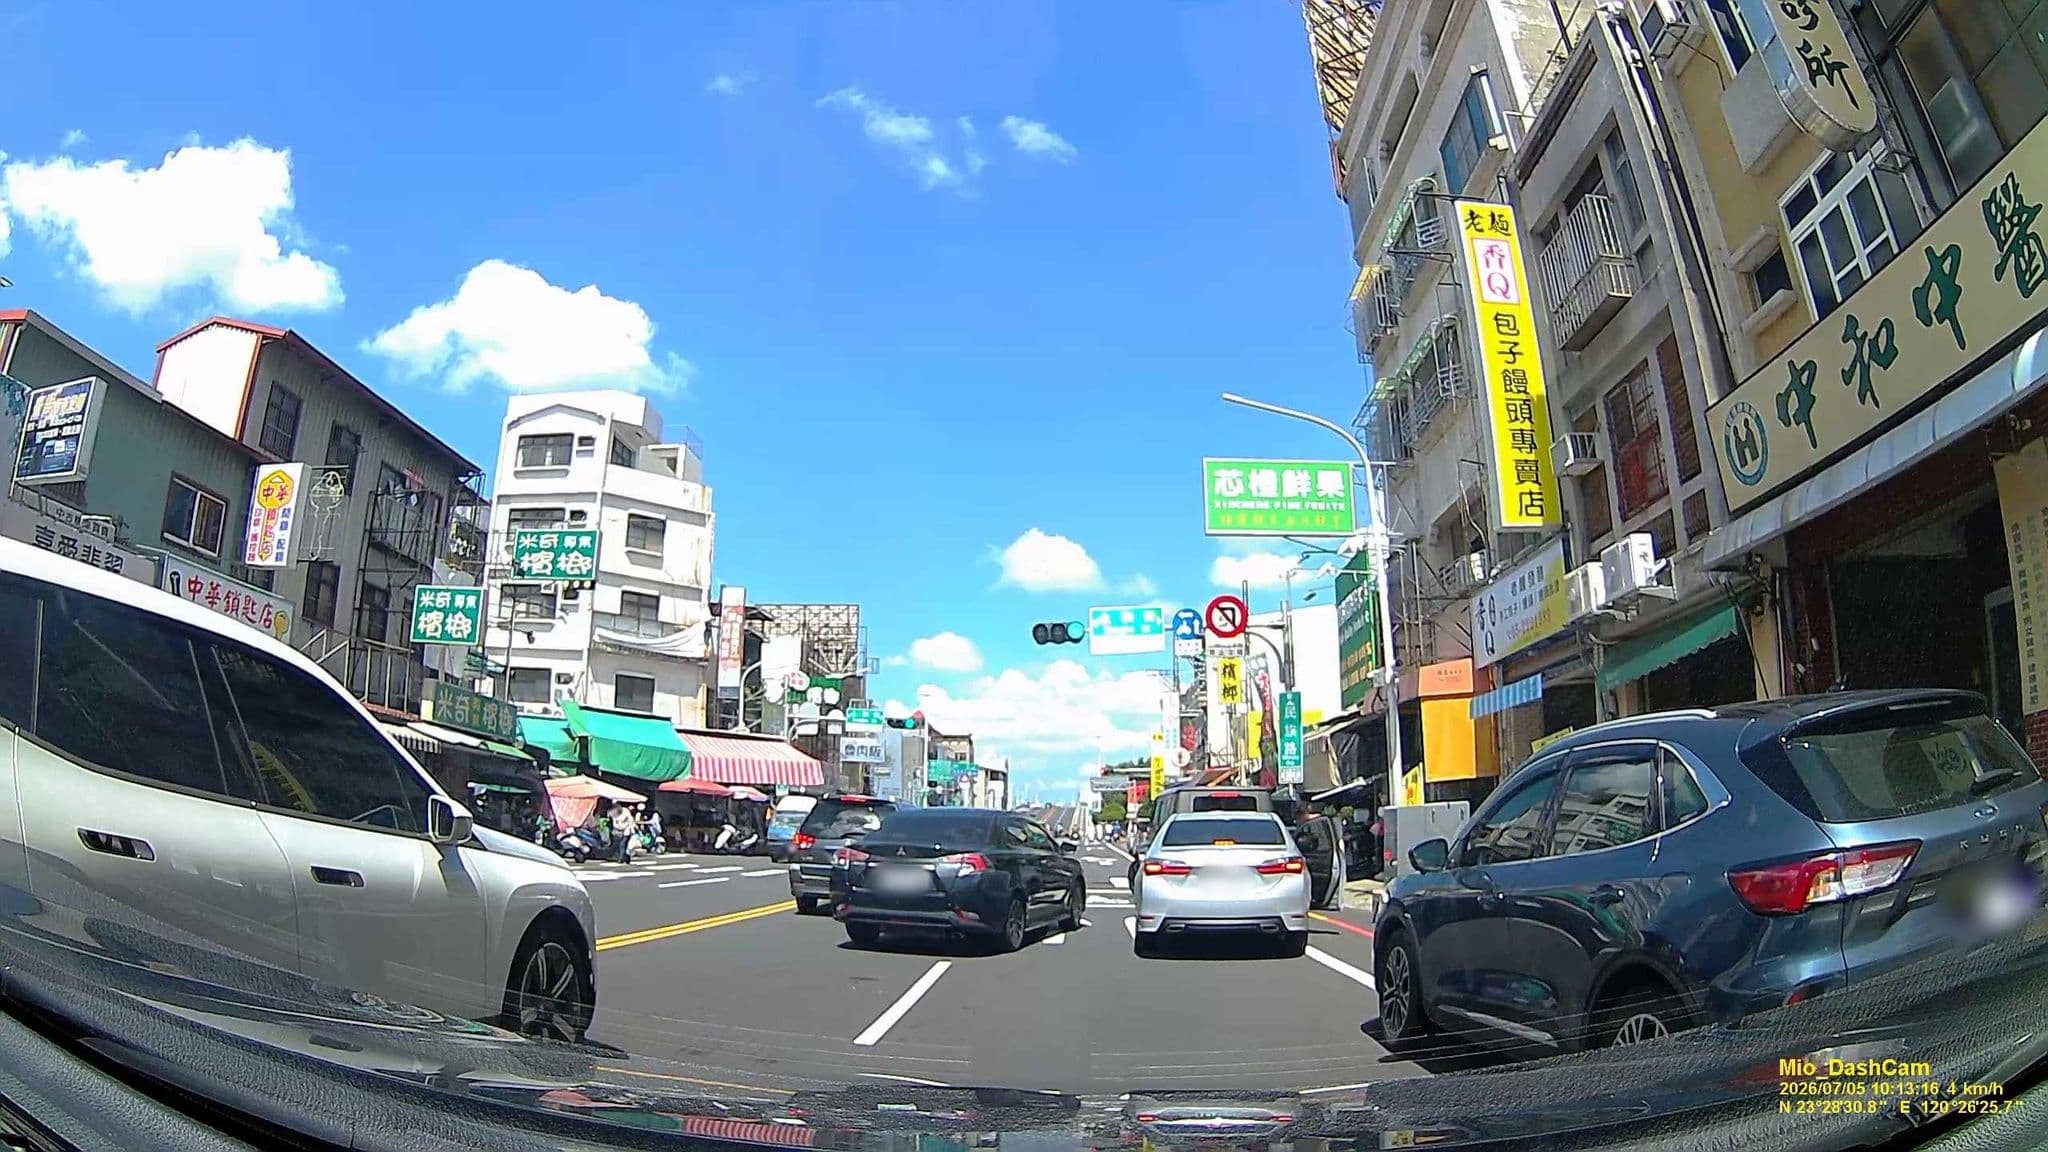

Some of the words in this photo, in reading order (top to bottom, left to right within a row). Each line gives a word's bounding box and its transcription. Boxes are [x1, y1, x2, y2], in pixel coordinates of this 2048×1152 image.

[1464, 209, 1512, 236] 老麵
[1776, 171, 2048, 449] 中和中醫
[1493, 311, 1545, 518] 包子饅頭專賣店
[263, 484, 288, 502] 中華
[518, 533, 560, 549] 米奇
[520, 550, 593, 576] 檳榔
[187, 574, 273, 629] 中華鎖匙店
[419, 590, 452, 608] 米奇
[417, 610, 472, 639] 檳榔
[1284, 700, 1297, 755] 民族路
